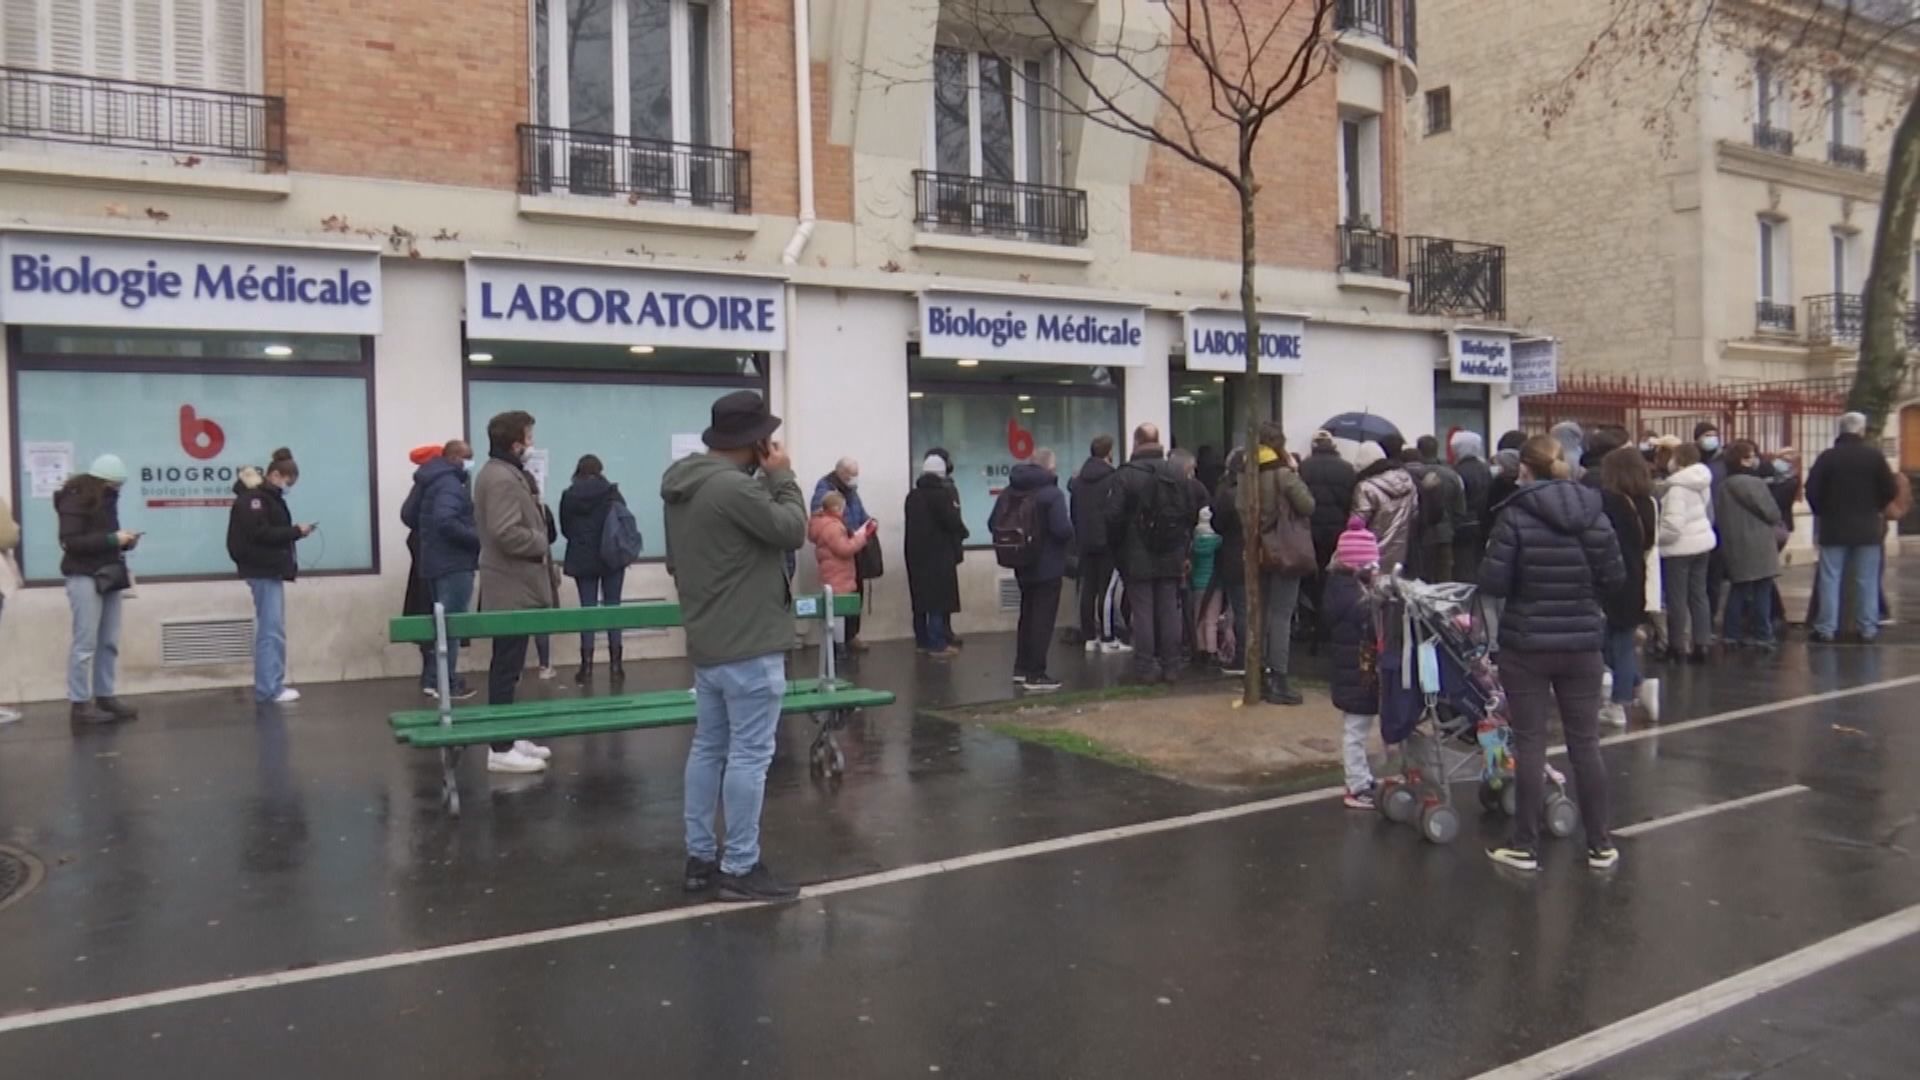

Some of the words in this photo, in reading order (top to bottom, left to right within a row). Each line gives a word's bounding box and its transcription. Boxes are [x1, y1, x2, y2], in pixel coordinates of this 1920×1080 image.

[11, 253, 182, 309] Biologie
[194, 263, 372, 306] Médicale
[481, 281, 776, 332] LABORATOIRE
[928, 306, 1027, 346] Biologie
[1036, 313, 1142, 346] Médicale
[1194, 329, 1301, 359] LABORTOIRE
[1460, 339, 1505, 360] Biologie
[1459, 360, 1508, 377] Médicale
[141, 466, 265, 482] BIOGRO
